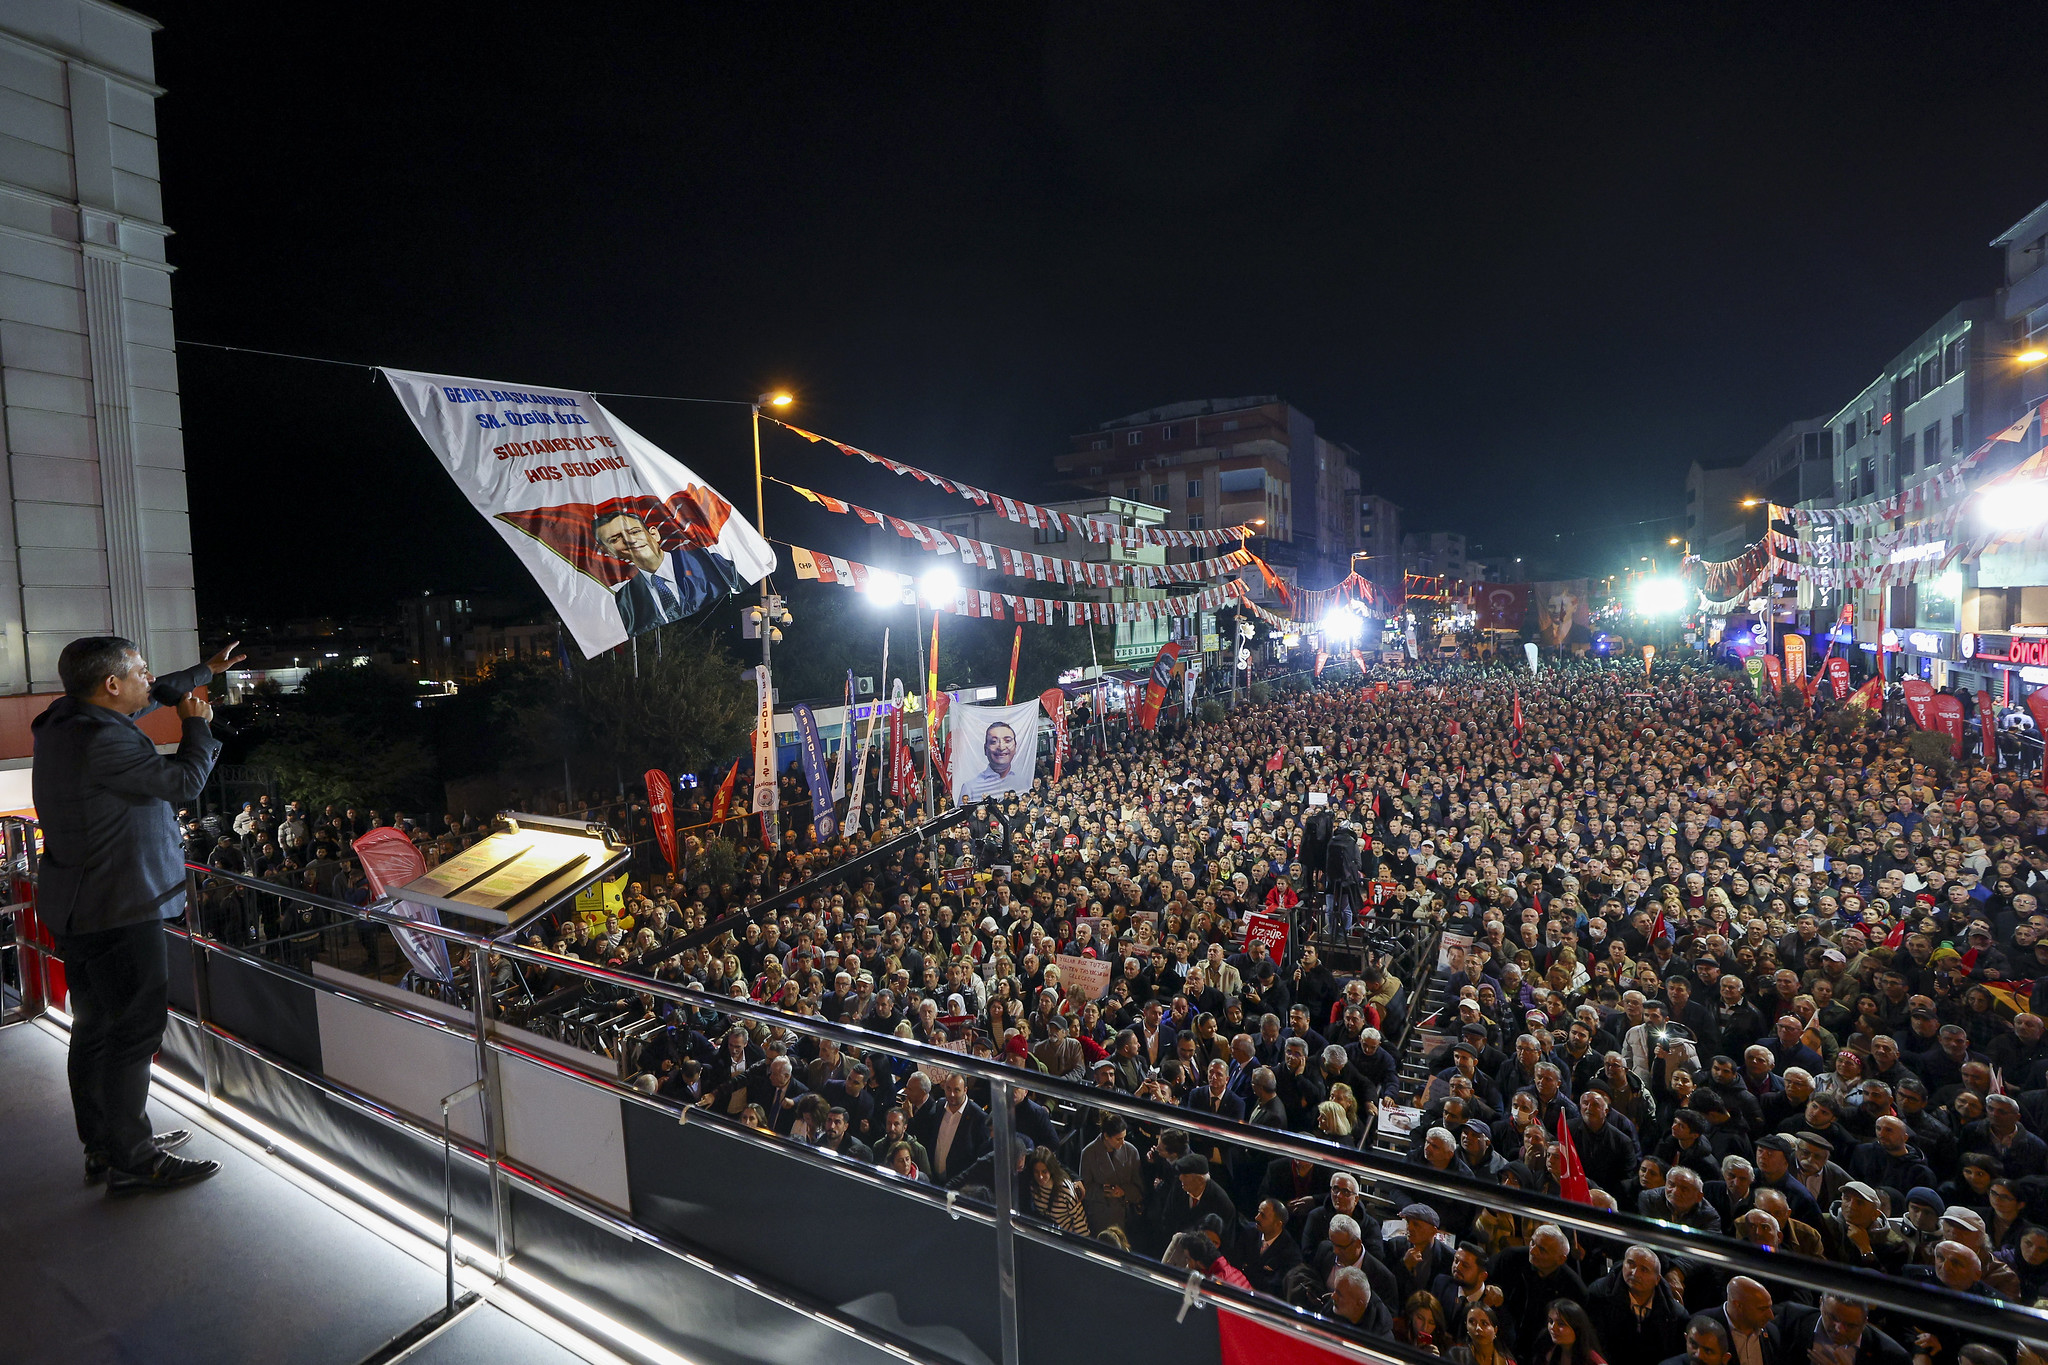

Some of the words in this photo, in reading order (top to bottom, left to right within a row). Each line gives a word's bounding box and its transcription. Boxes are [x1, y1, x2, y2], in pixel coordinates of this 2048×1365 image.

[443, 387, 490, 404] GENEL
[490, 390, 580, 407] BAŞKANIMIZ
[475, 413, 506, 429] SN.
[503, 409, 556, 427] ÖZGÜR
[553, 410, 590, 425] ÖZEL
[524, 466, 563, 484] HOŞ
[560, 455, 630, 479] GELDİNİZ
[1251, 925, 1285, 940] ÖZGÜR-
